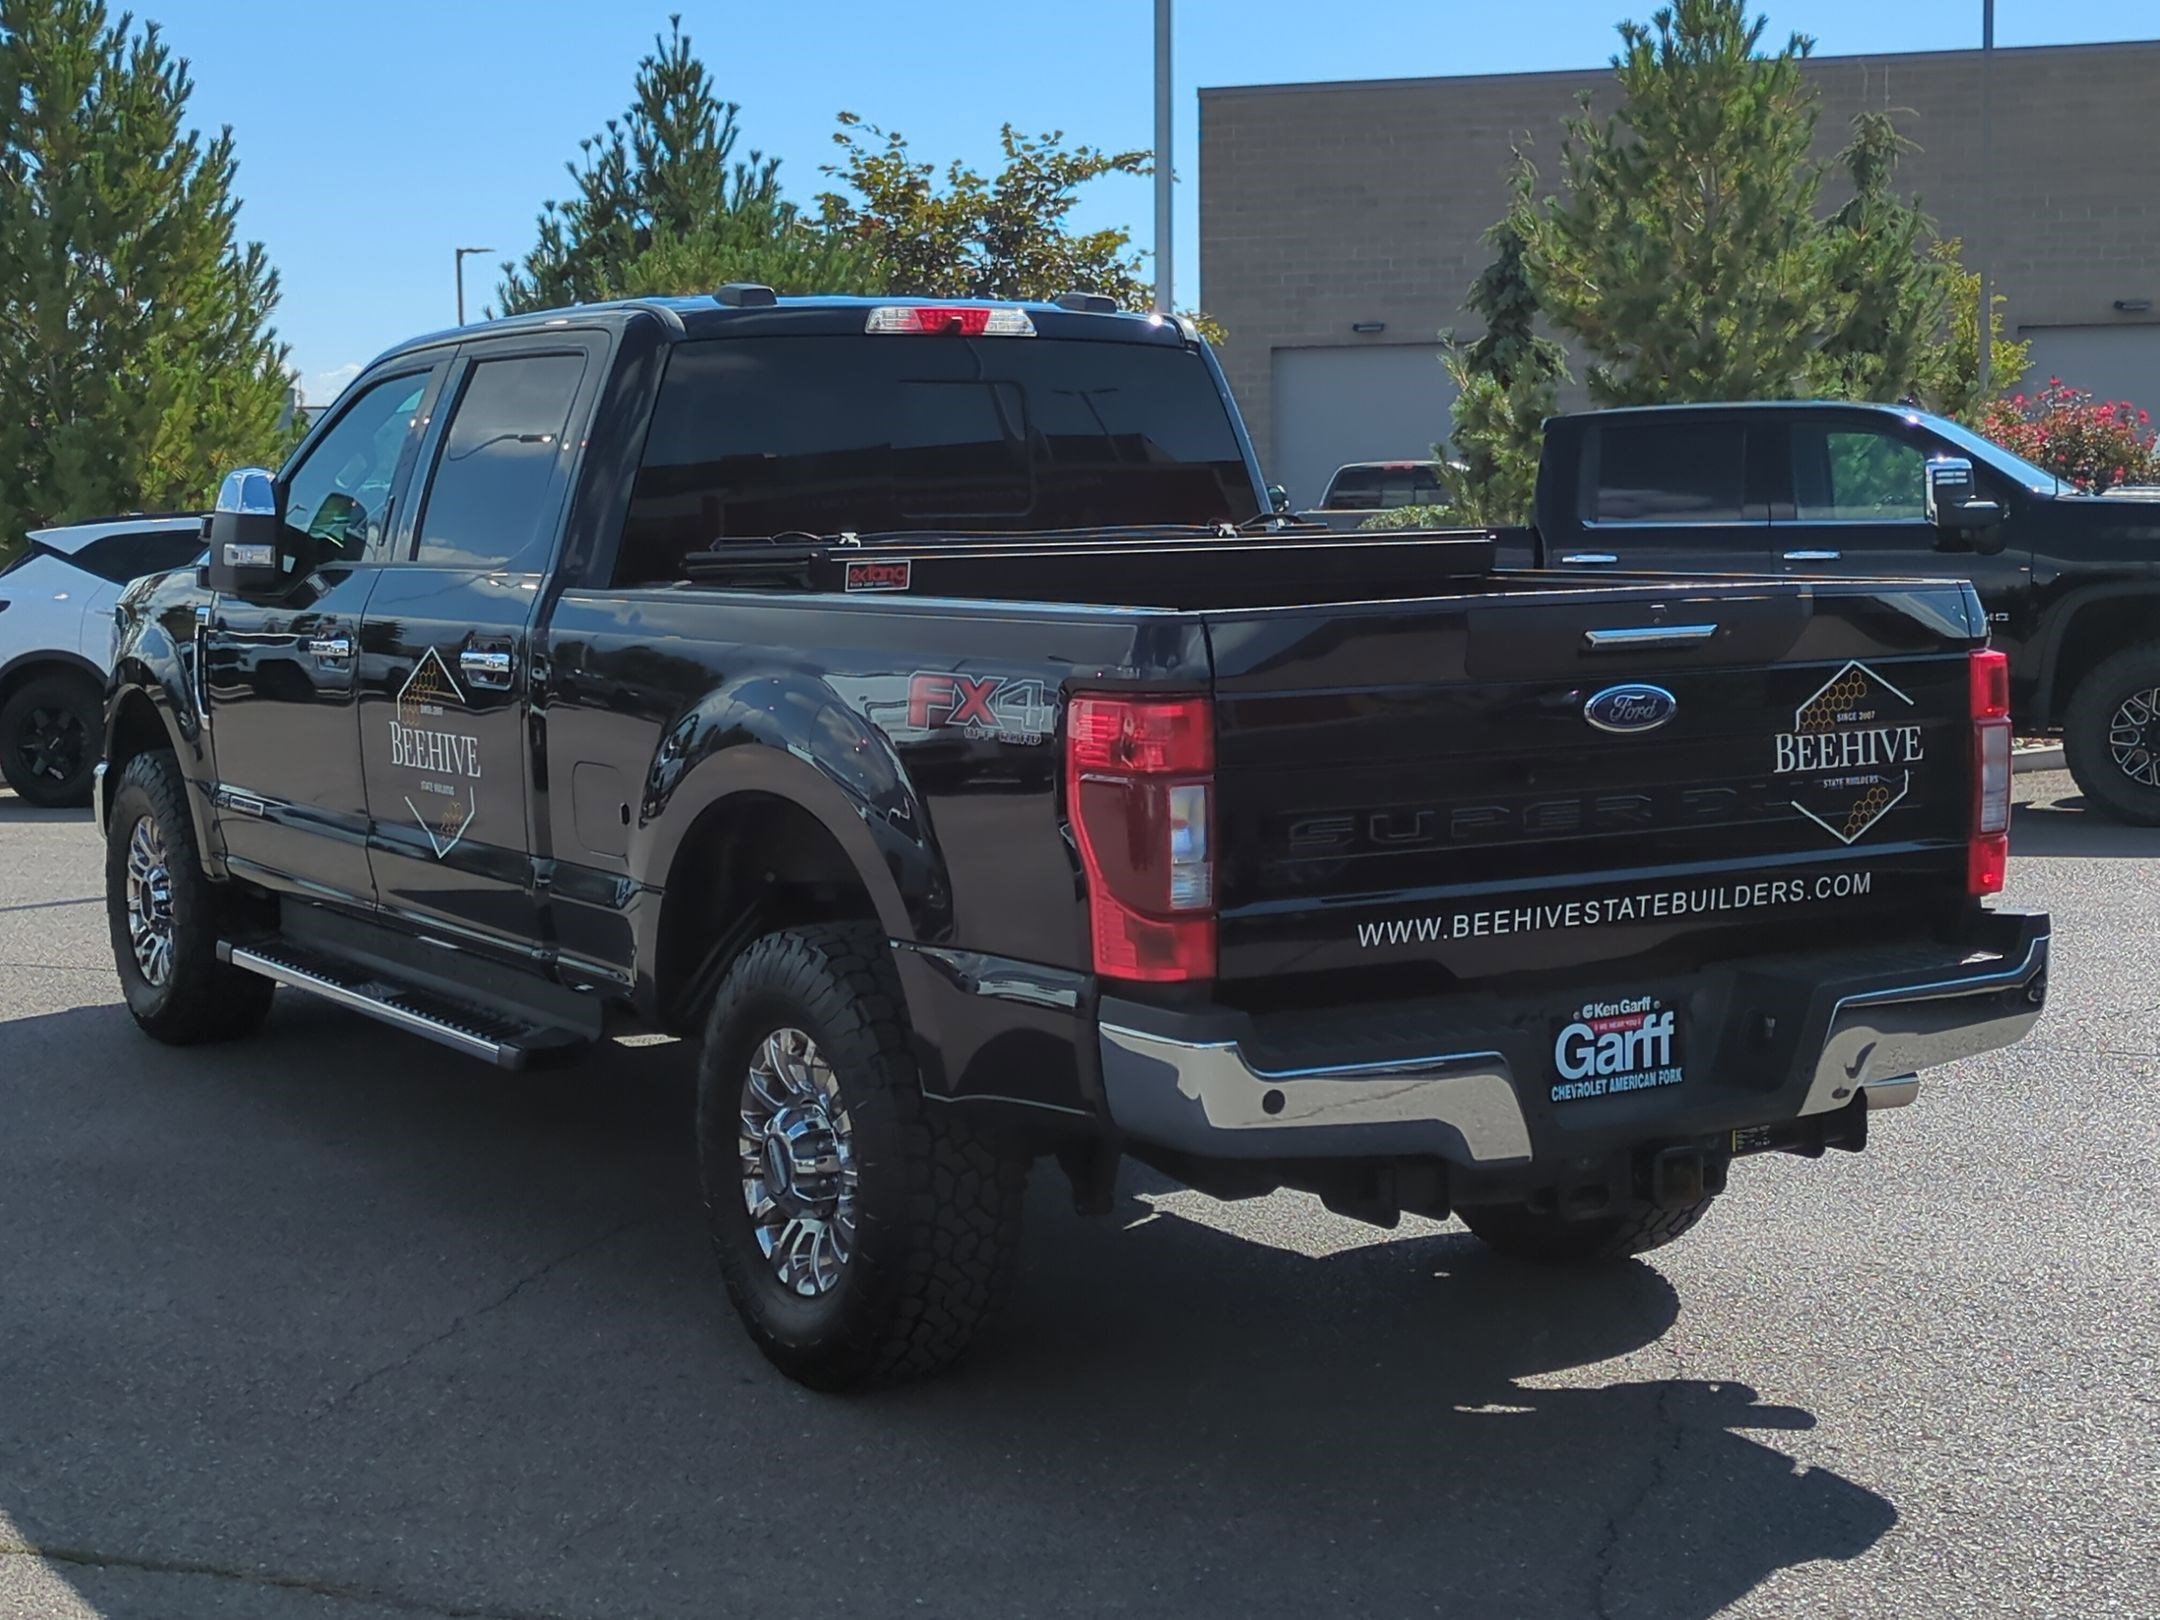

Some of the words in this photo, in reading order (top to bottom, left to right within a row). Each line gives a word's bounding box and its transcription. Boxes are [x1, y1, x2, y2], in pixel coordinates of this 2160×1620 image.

[906, 671, 1044, 731] FX4
[1610, 694, 1657, 721] Ford
[389, 721, 481, 778] BEEHIVE
[1773, 726, 1924, 773] BEEHIVE
[1289, 794, 1653, 847] SUPER
[1357, 871, 1872, 948] WWW.BEEHIVESTATEBUILDERS.COM
[1594, 1002, 1619, 1018] Ken
[1620, 996, 1651, 1014] Garff
[1555, 1011, 1674, 1080] Garff
[1551, 1079, 1607, 1102] CHEVROLET
[1609, 1072, 1657, 1093] AMERICAN
[1658, 1067, 1683, 1085] FORK
